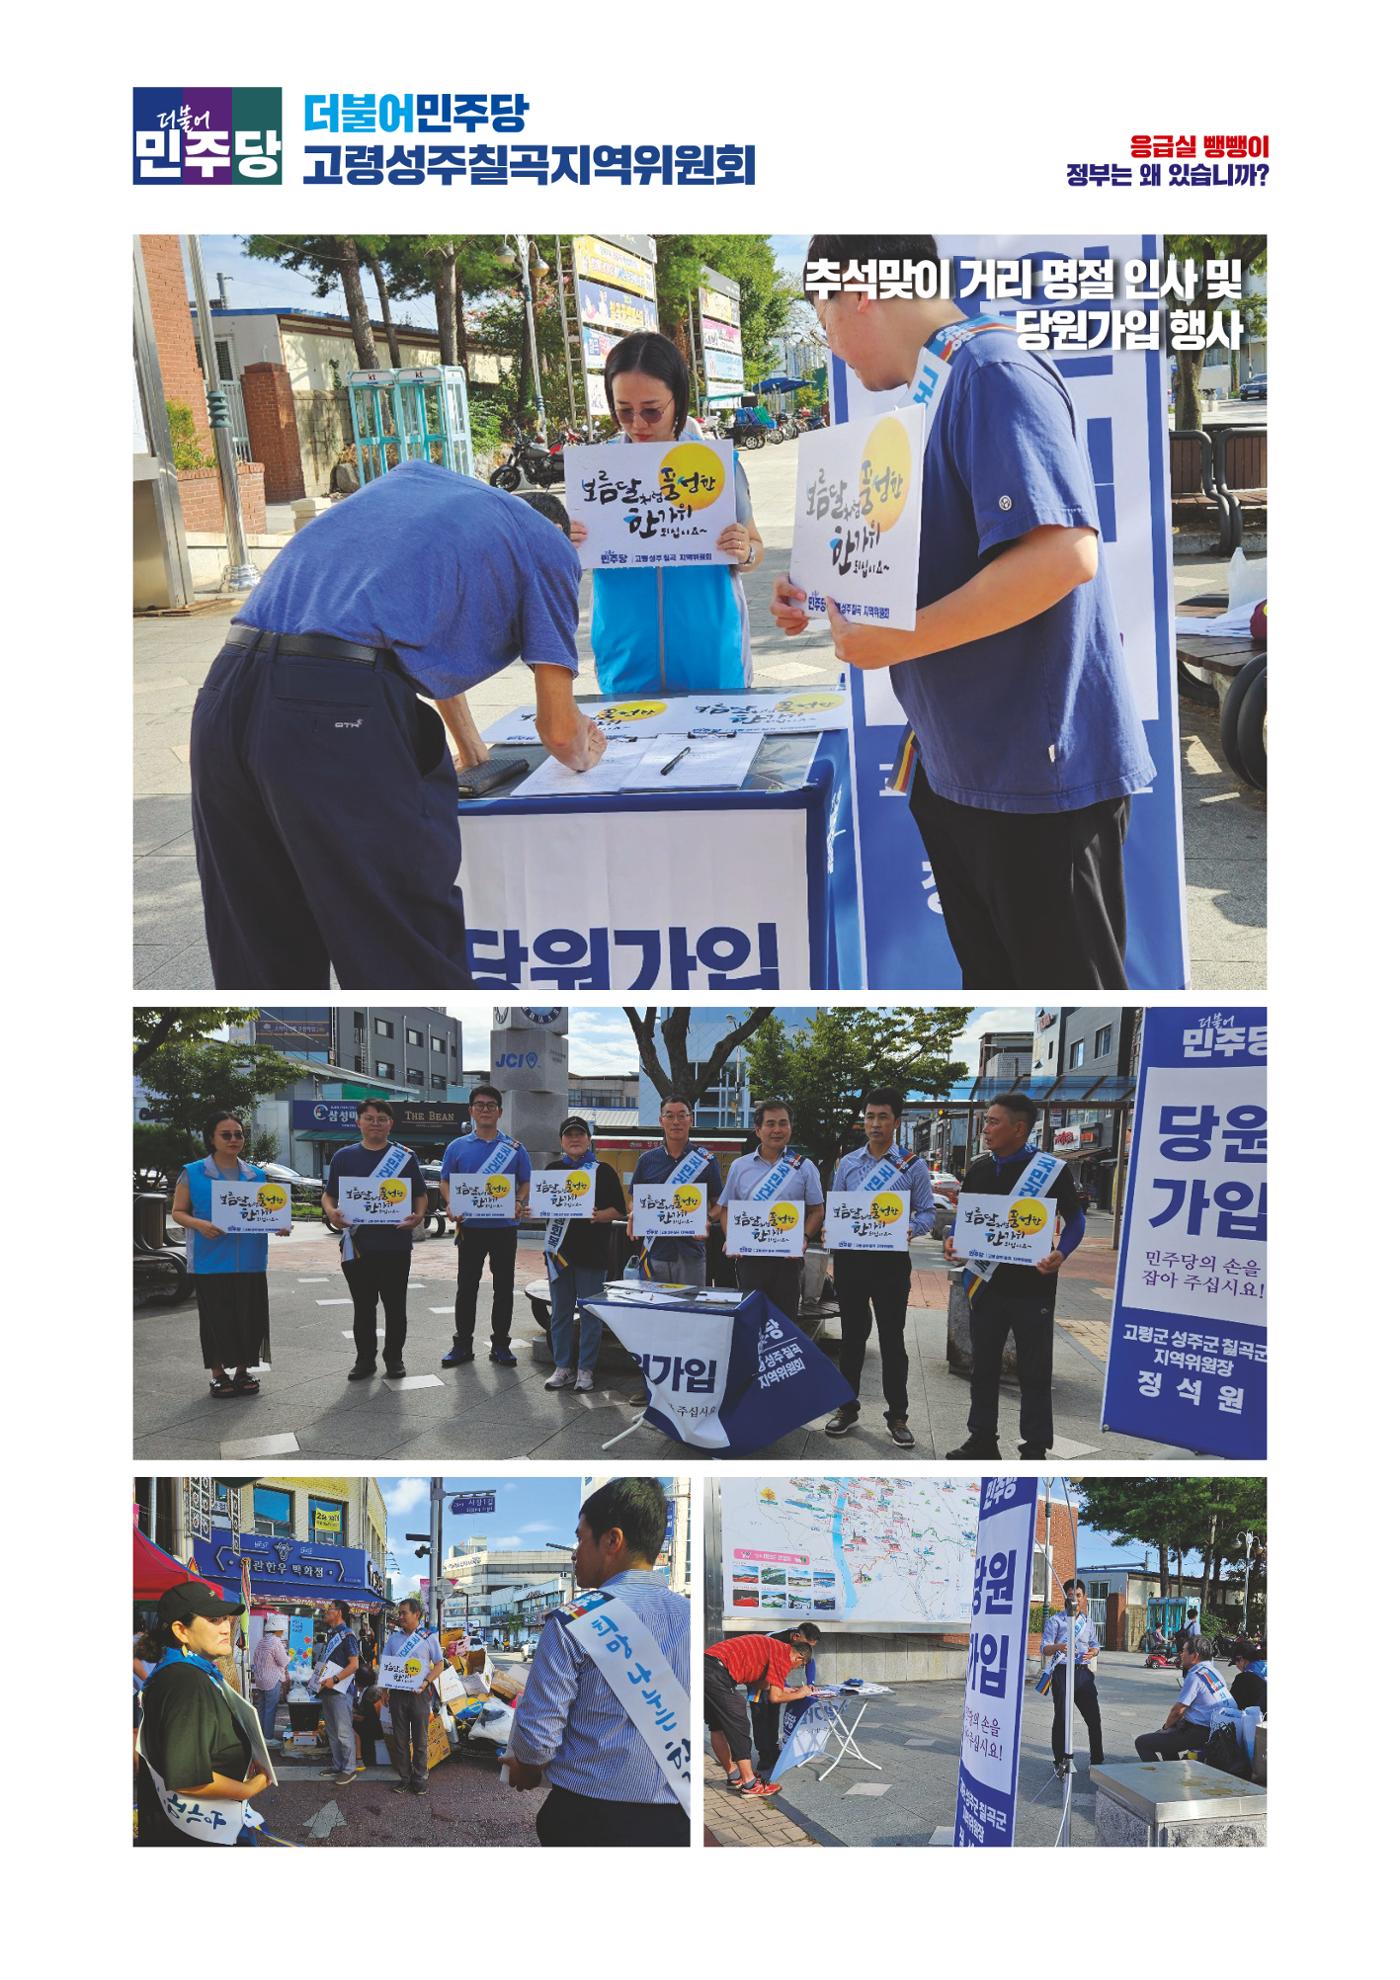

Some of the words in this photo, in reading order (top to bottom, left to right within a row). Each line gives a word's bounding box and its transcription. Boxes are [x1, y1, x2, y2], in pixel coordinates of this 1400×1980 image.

[660, 467, 716, 501] 풍성한
[624, 504, 693, 539] 한가위
[829, 520, 881, 577] 한가위
[1198, 1012, 1235, 1029] 더불어
[496, 1053, 524, 1068] JCI
[405, 1110, 425, 1121] THE
[429, 1110, 455, 1121] BEAN
[1148, 1178, 1267, 1241] 가입
[1145, 1250, 1216, 1273] 민주당의
[1223, 1257, 1261, 1278] 손을
[1142, 1269, 1178, 1289] 잡아
[1183, 1273, 1265, 1299] 주십시요!
[1123, 1324, 1168, 1346] 고령군
[1171, 1330, 1219, 1354] 성주군
[1221, 1338, 1267, 1363] 칠곡군
[758, 1357, 806, 1389] 지역위원회
[1153, 1348, 1235, 1378] 지역위원장
[292, 1564, 324, 1578] 백화점
[591, 1615, 632, 1660] 희망
[981, 1716, 1001, 1738] 손을
[979, 1801, 1007, 1832] 칠곡군
